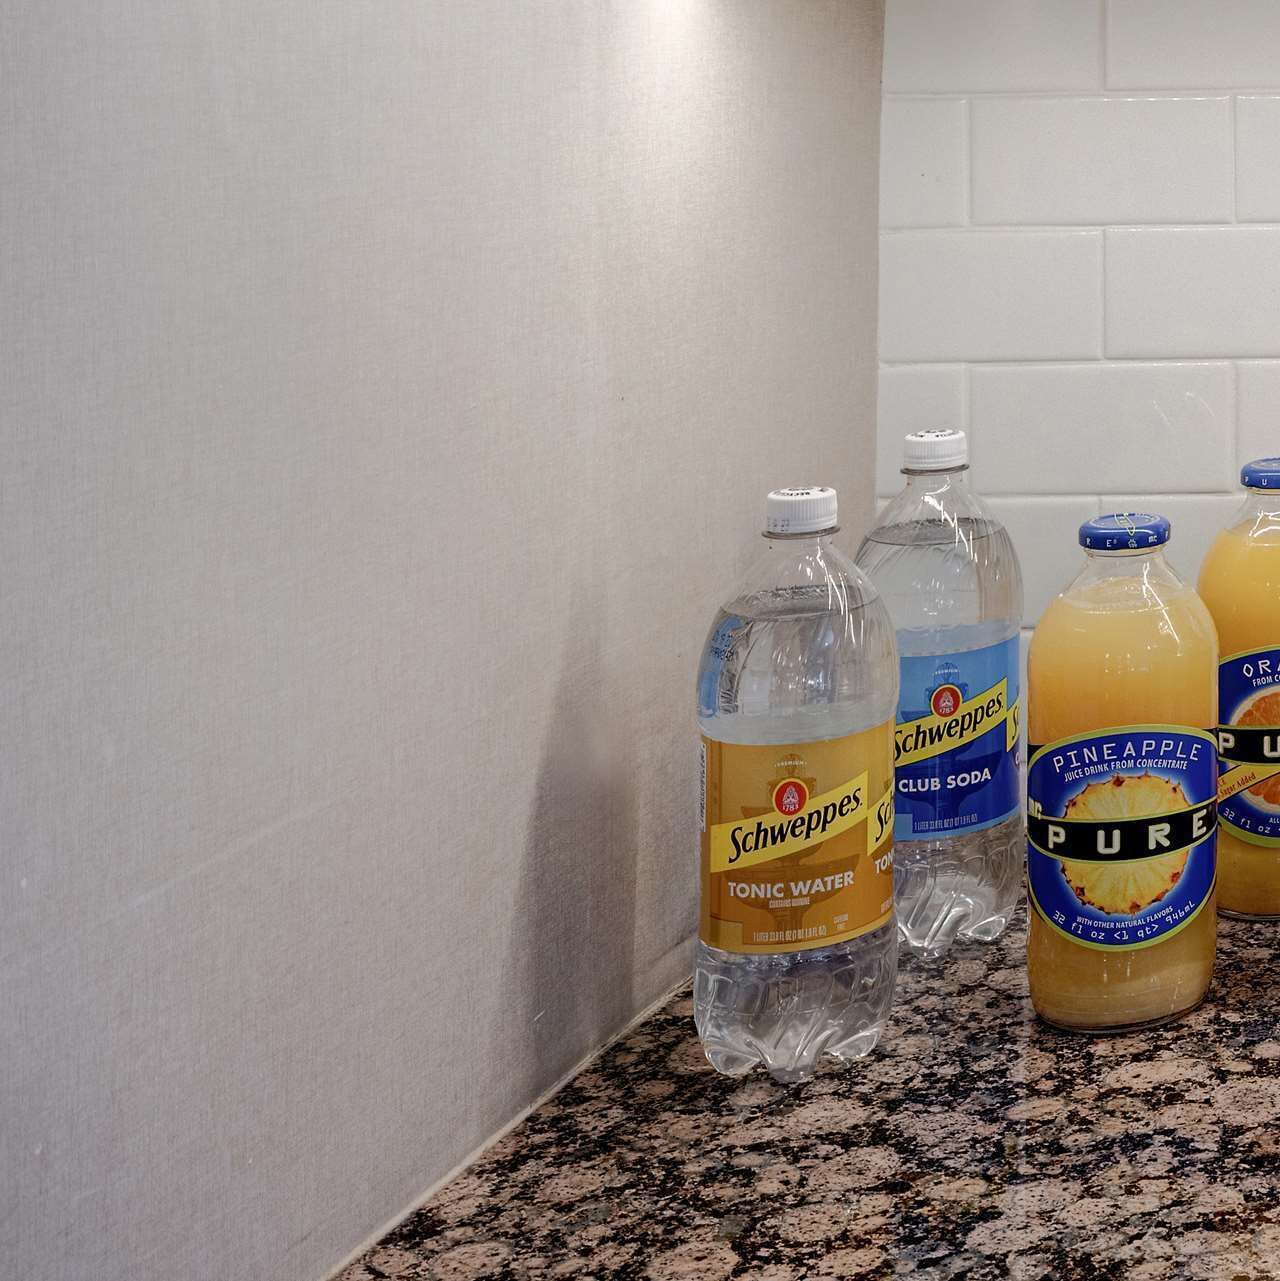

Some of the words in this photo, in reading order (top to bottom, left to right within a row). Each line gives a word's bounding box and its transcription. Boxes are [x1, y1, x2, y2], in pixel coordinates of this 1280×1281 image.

[1252, 674, 1273, 688] FROM
[939, 706, 954, 714] 1783
[1053, 740, 1202, 773] PINEAPPLE
[898, 777, 941, 792] CLUB
[946, 768, 992, 788] SODA
[1064, 768, 1084, 782] JUICE
[1084, 763, 1109, 778] DRINK
[1111, 760, 1134, 770] FROM
[1136, 758, 1188, 770] CONCENTRATE
[1237, 773, 1257, 788] Added
[782, 803, 800, 812] 1783
[1048, 808, 1208, 855] PURE
[1223, 807, 1235, 820] 32
[1258, 824, 1270, 834] oz
[728, 880, 785, 898] TONIC
[790, 870, 854, 898] WATER
[1052, 910, 1066, 924] 32
[1071, 923, 1082, 934] fl
[1090, 930, 1104, 940] oz
[1166, 900, 1196, 924] 946mL
[1076, 916, 1092, 928] WITH
[1092, 920, 1115, 929] OTHER
[1115, 918, 1146, 929] NATURAL
[1146, 905, 1174, 924] FLAVORS
